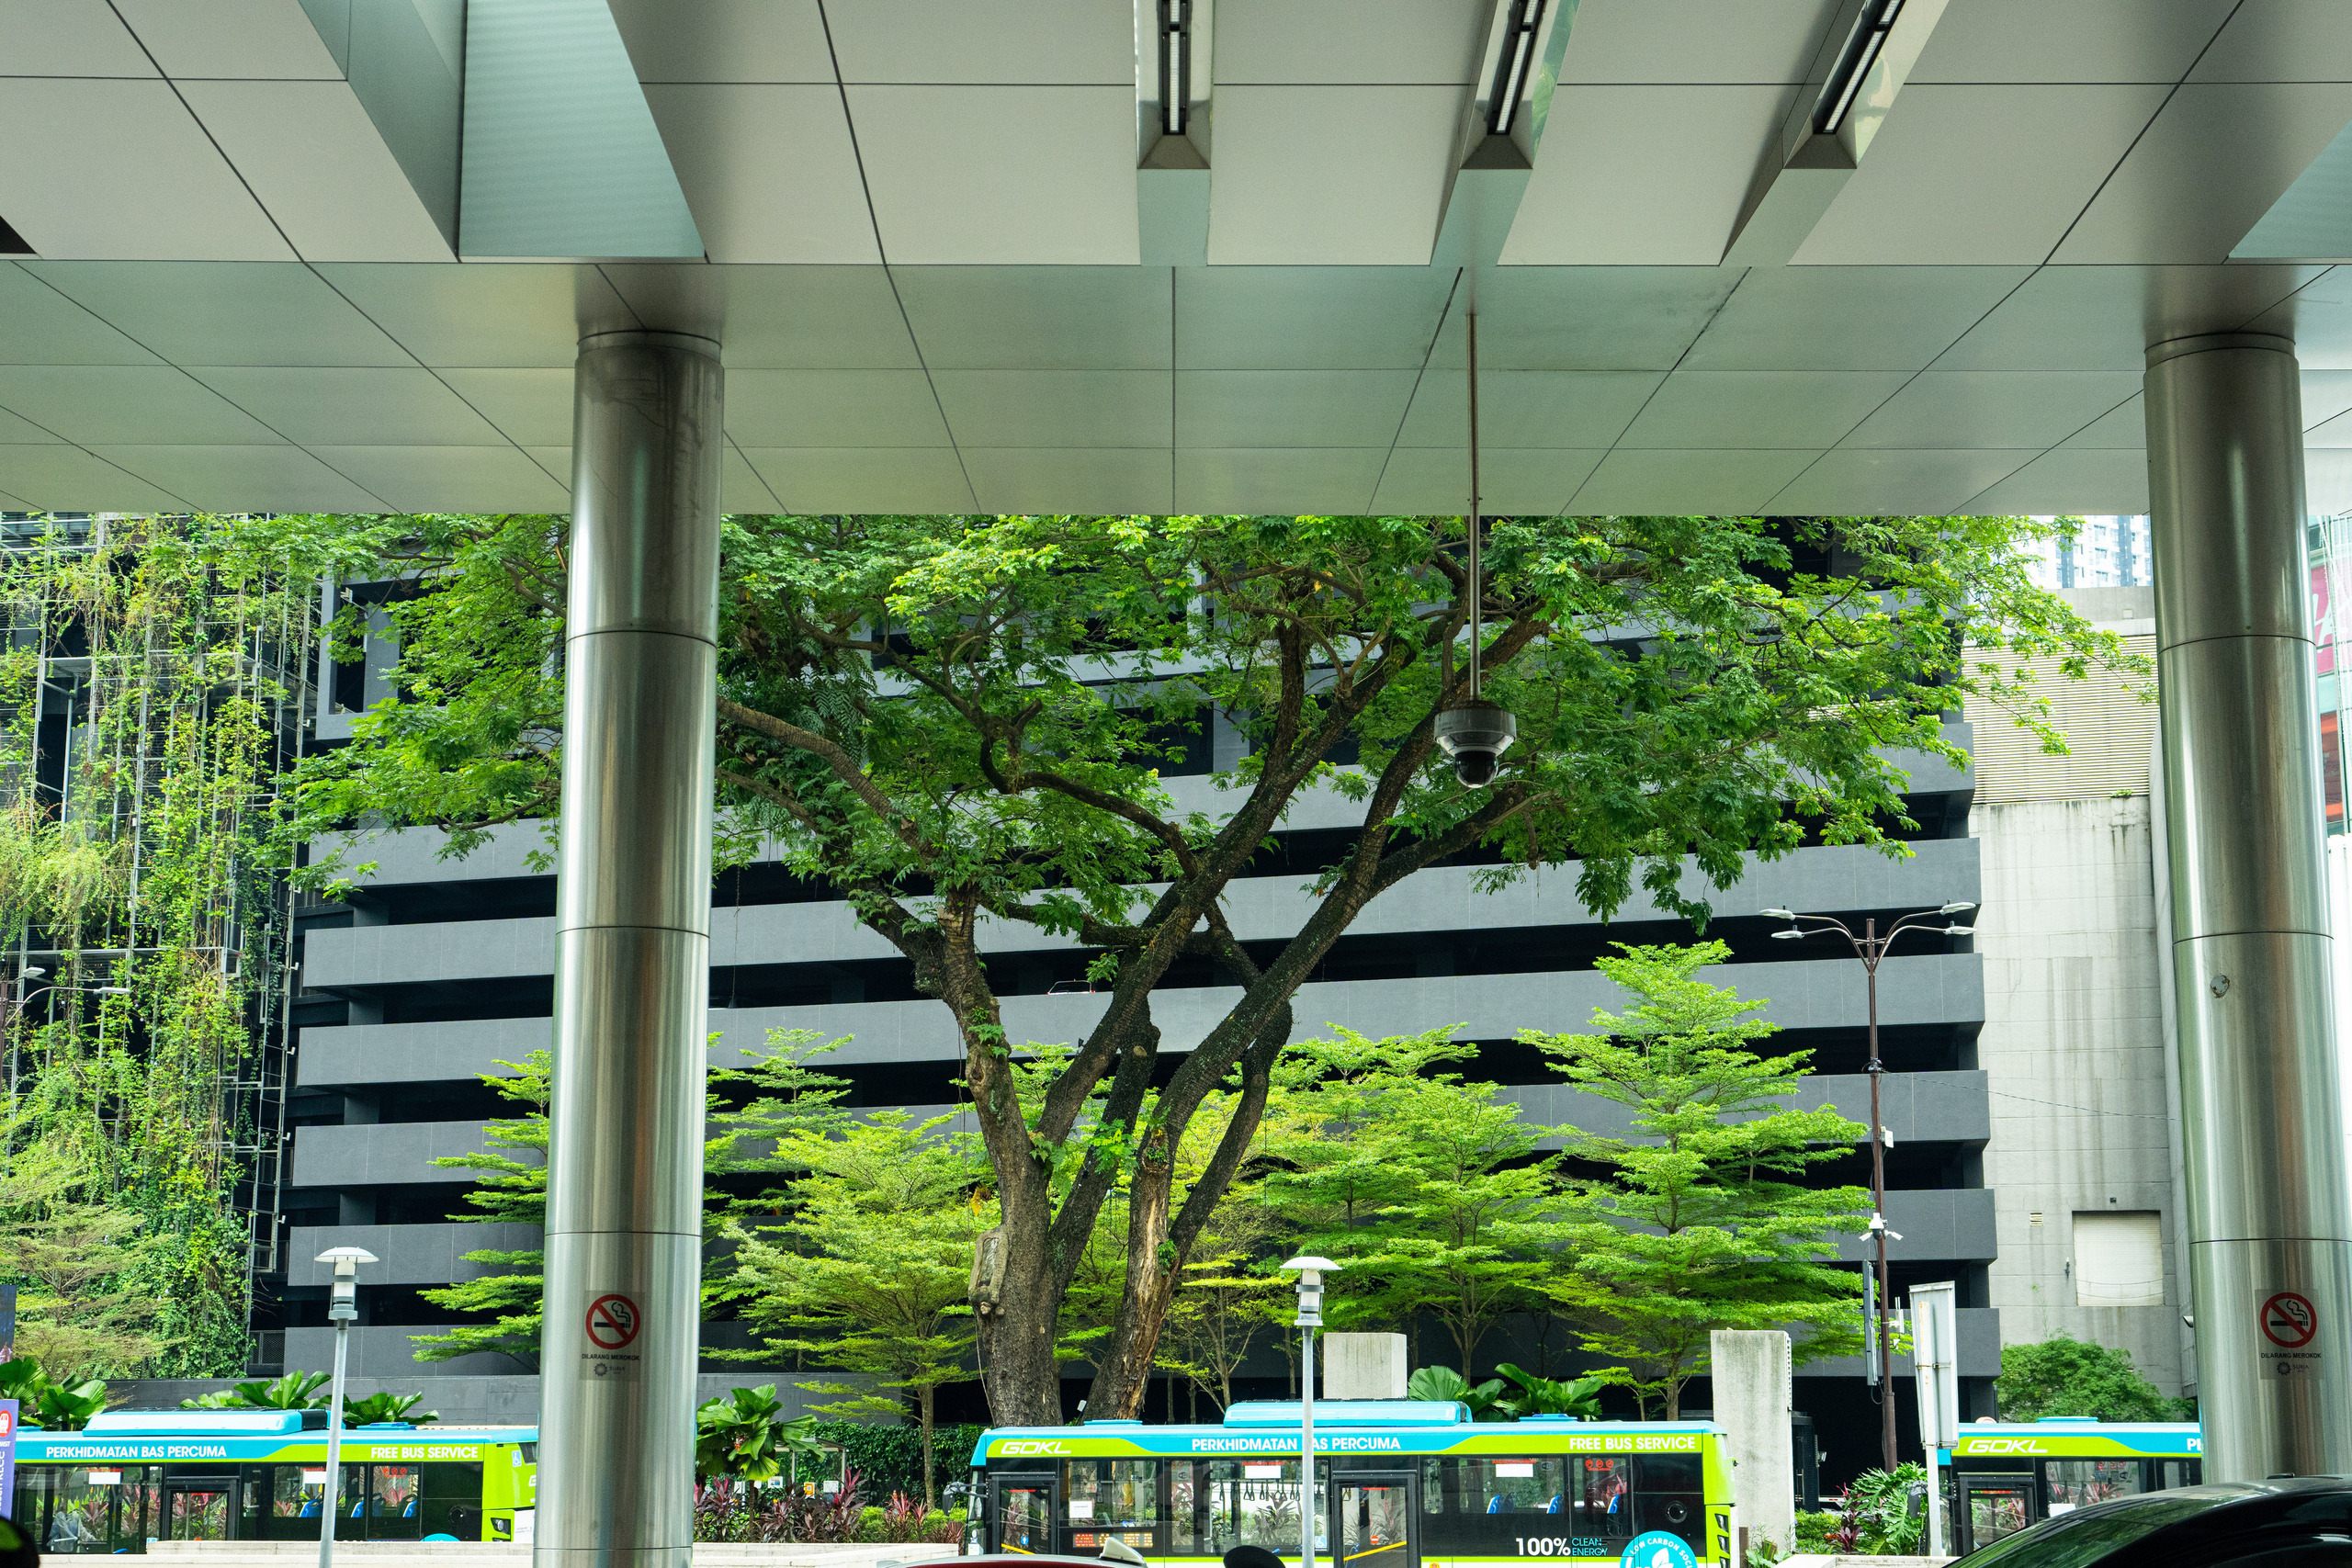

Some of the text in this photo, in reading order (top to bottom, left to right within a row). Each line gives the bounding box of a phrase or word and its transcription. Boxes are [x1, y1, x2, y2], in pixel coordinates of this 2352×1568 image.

[1001, 1441, 1072, 1455] GOKL
[1192, 1437, 1401, 1450] PERKHIDMATAN AS PERCUMA
[1569, 1436, 1696, 1450] FREE BUS SERVICE
[1967, 1439, 2049, 1453] GOKL
[46, 1446, 227, 1458] PERKHIDMATAN BAS PERCUMA
[370, 1446, 479, 1459] FREE BUS SERVICE
[1515, 1537, 1571, 1556] 100%
[1571, 1537, 1602, 1546] CLEAN
[1629, 1540, 1645, 1555] LOW
[1647, 1537, 1680, 1551] CARBON
[1572, 1547, 1608, 1556] ENERGY
